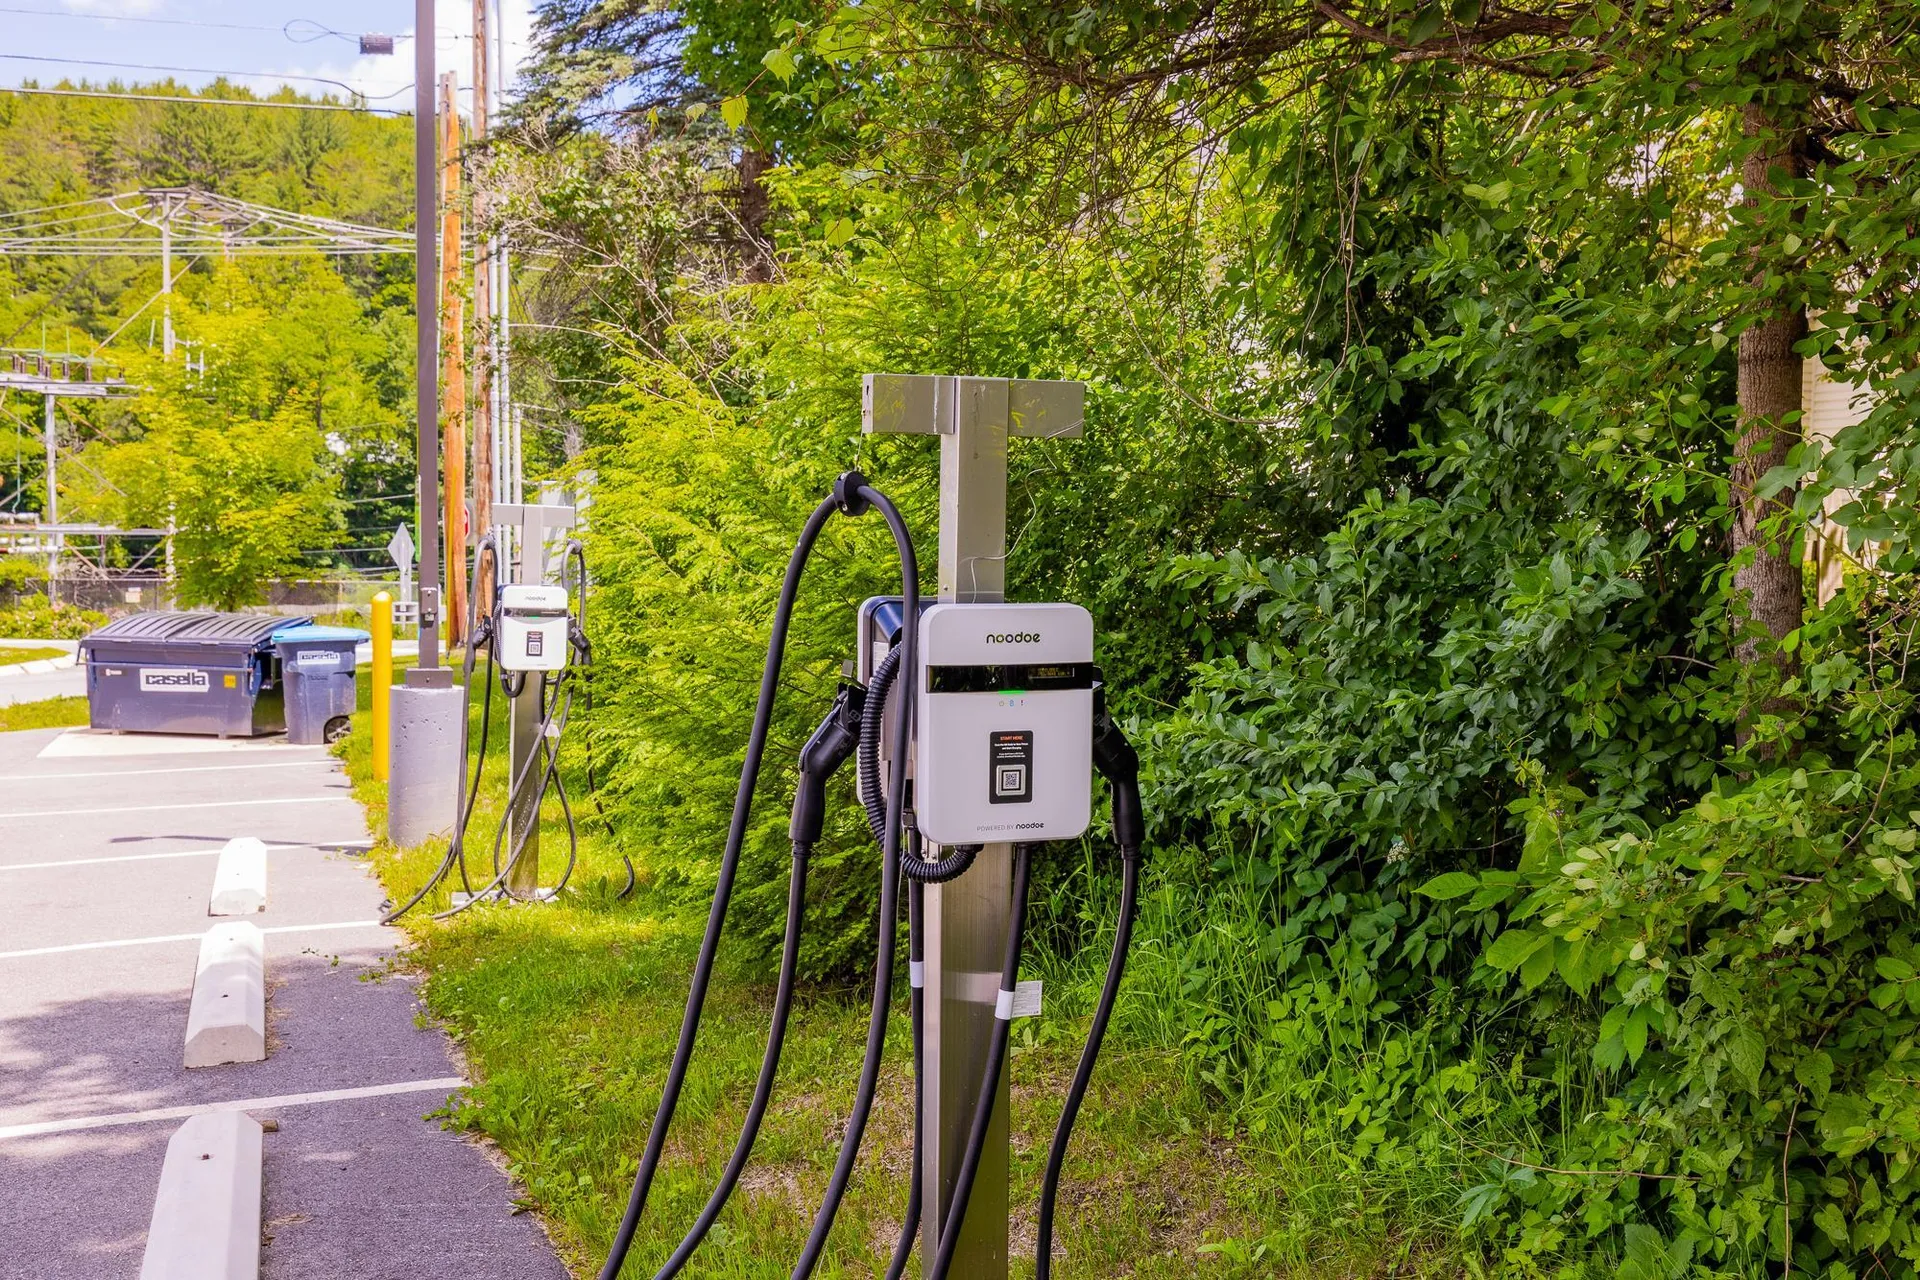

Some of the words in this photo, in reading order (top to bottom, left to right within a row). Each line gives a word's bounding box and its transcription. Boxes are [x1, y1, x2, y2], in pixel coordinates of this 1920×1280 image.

[986, 631, 1041, 644] noodoe
[145, 672, 206, 685] casella
[1015, 822, 1045, 830] noodoe
